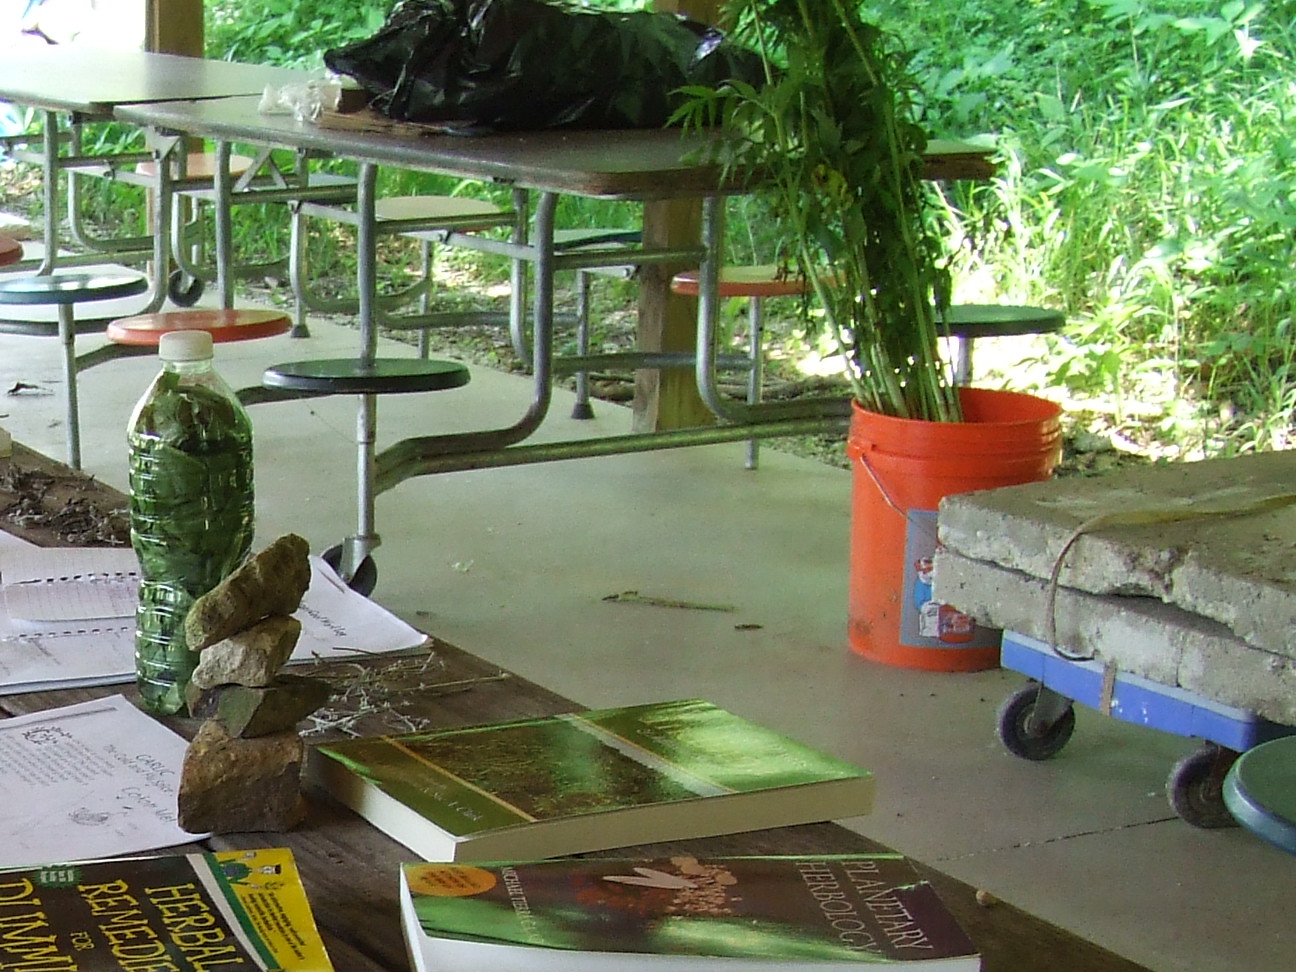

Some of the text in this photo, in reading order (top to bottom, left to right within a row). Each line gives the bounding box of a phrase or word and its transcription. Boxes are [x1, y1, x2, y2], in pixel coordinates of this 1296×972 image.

[136, 754, 175, 776] GARLIC
[795, 860, 882, 953] HERBOLOGY
[841, 860, 933, 951] PLANETARY
[70, 931, 95, 951] FOR
